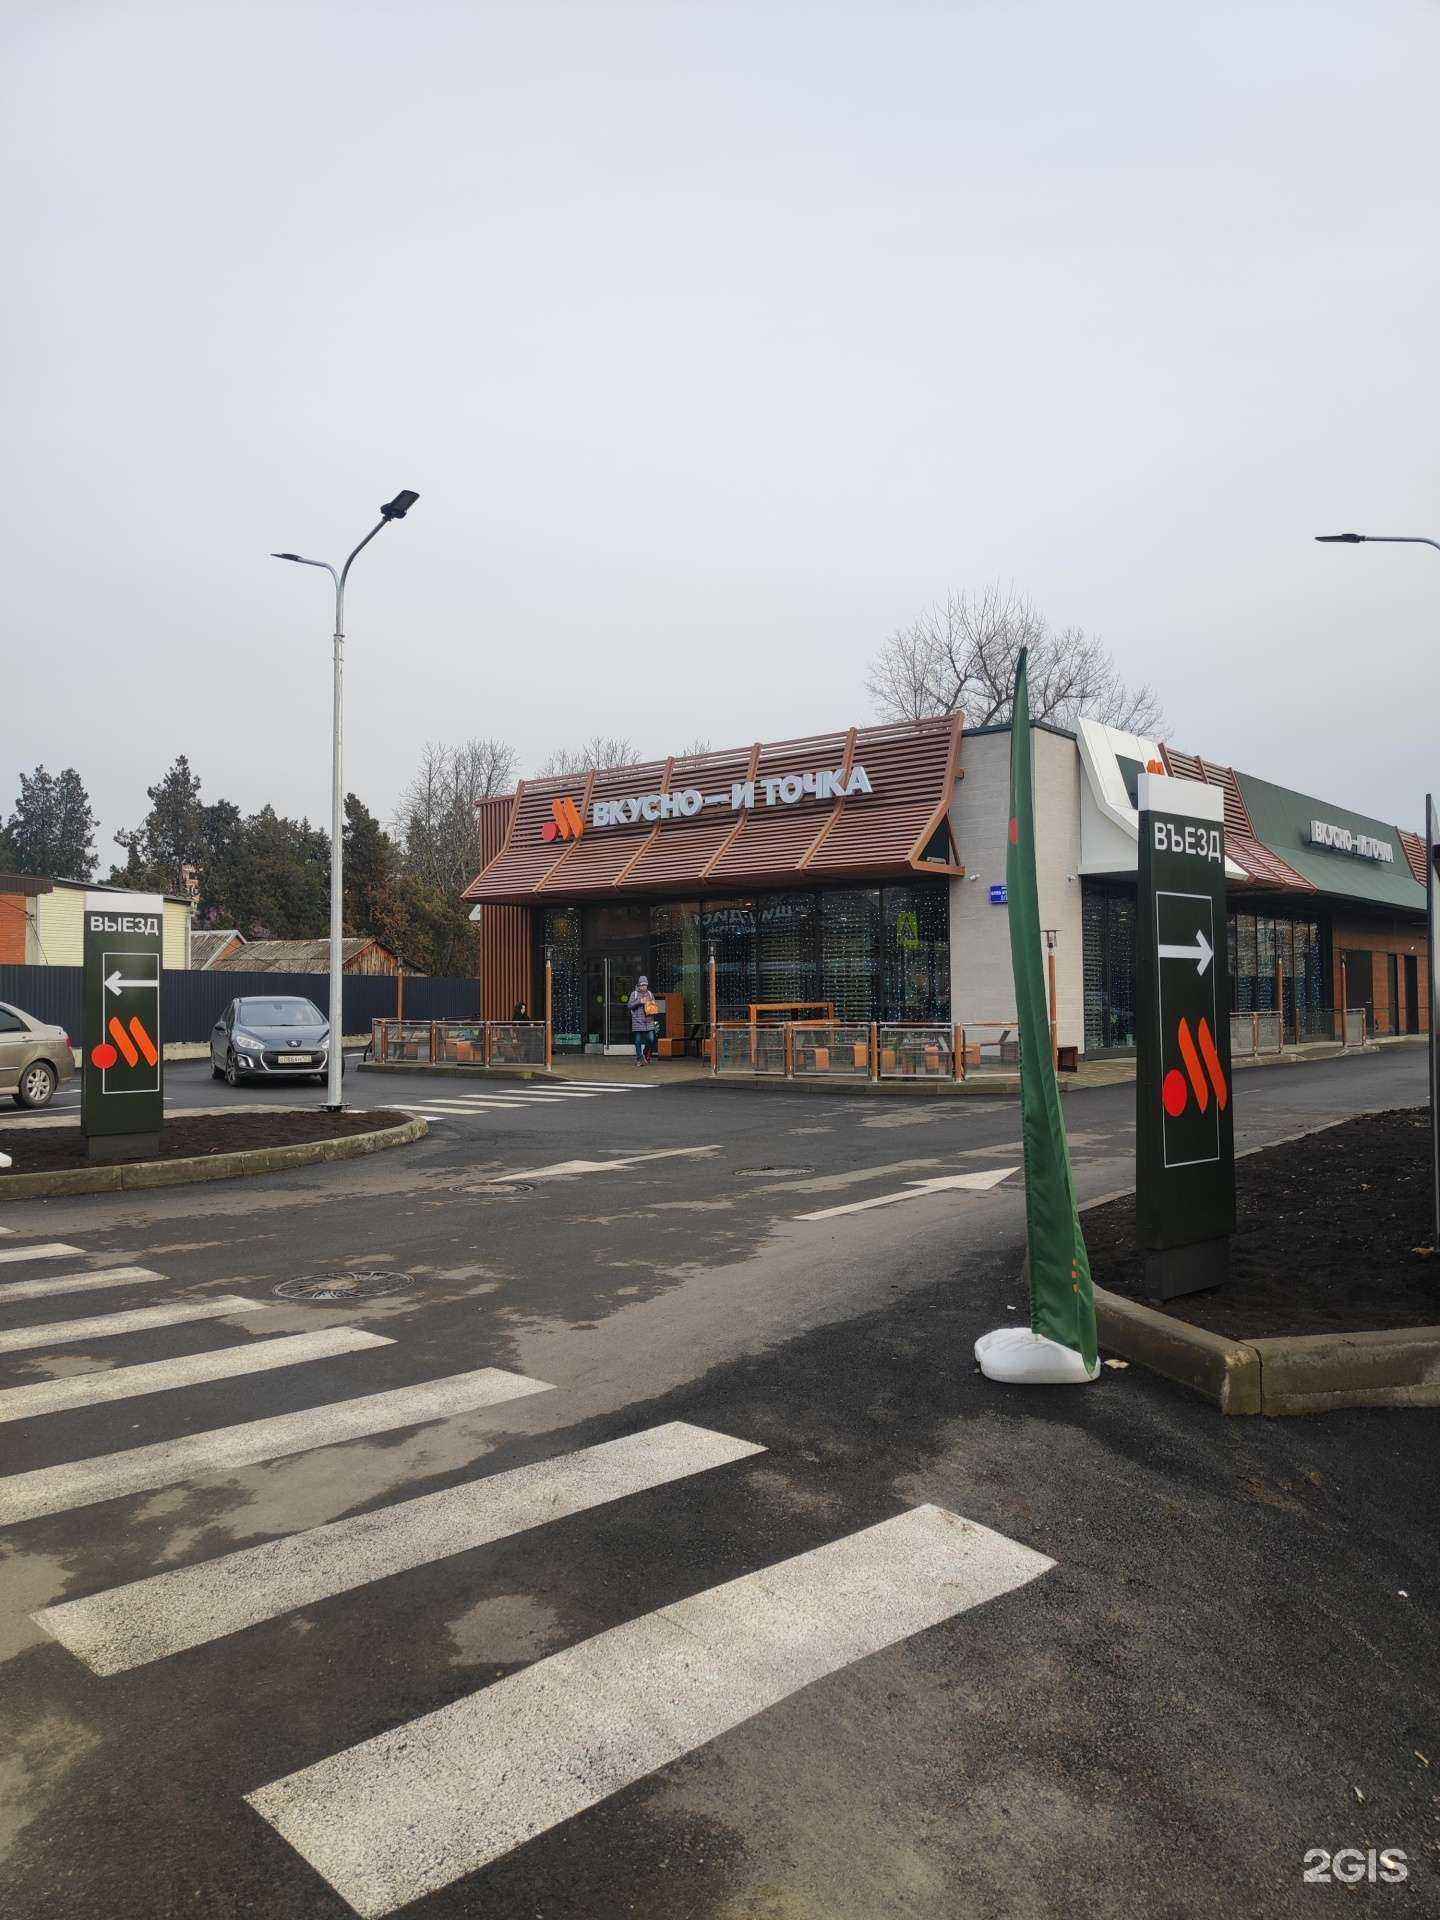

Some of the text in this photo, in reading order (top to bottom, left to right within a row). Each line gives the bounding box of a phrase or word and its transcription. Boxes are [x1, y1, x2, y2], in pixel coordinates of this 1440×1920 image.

[760, 764, 873, 806] ТОЧКА
[1154, 821, 1222, 864] ВЪЕЗД
[90, 915, 159, 937] ВЫЕЗД
